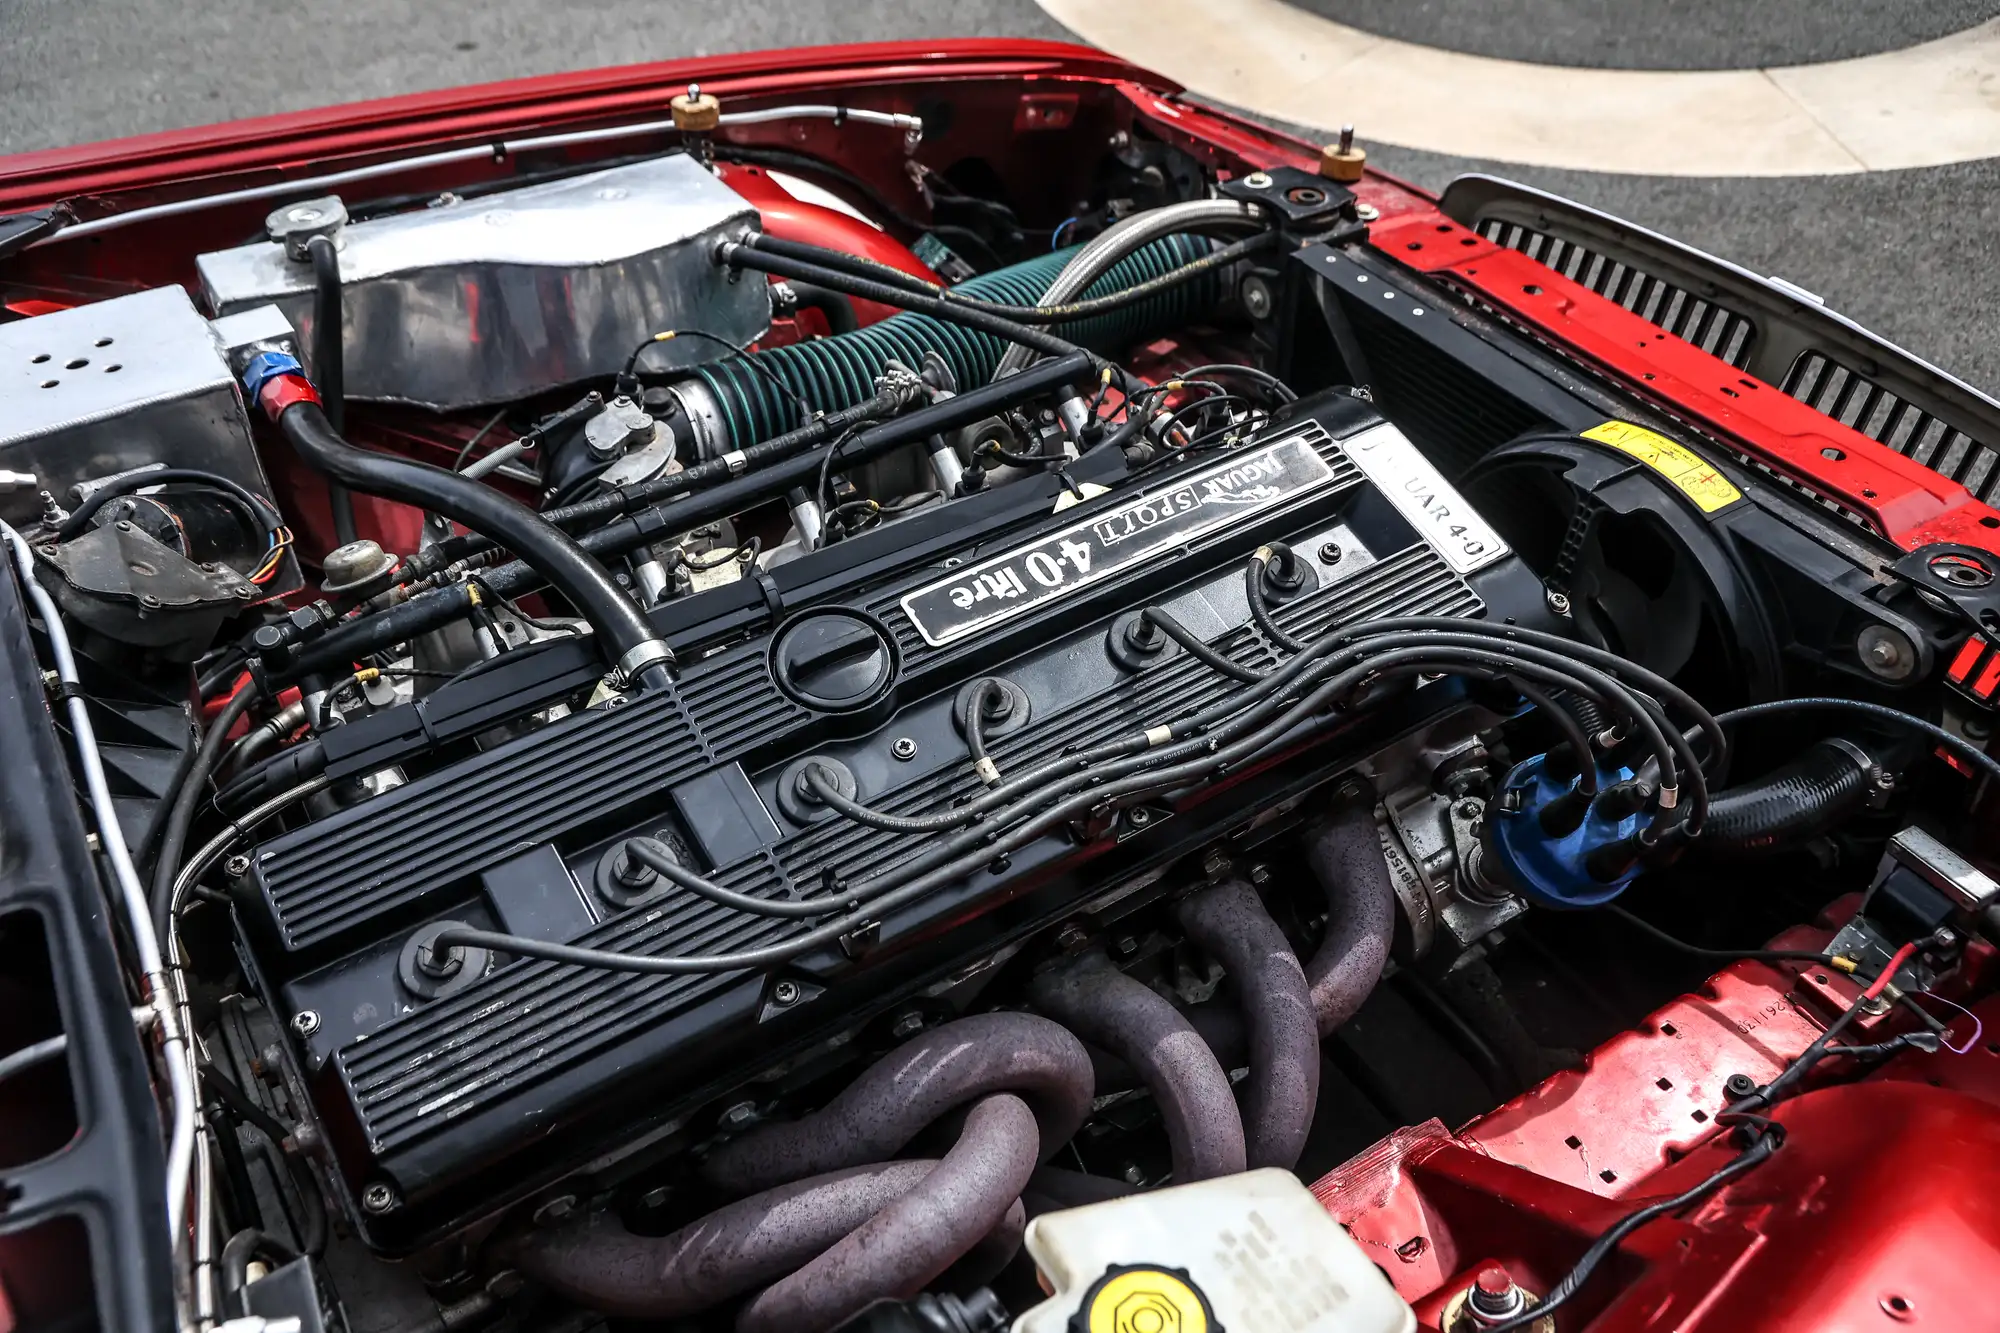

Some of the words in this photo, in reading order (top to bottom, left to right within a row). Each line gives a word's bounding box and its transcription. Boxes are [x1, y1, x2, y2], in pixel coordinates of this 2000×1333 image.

[1201, 452, 1286, 494] JAGUAR
[1361, 441, 1450, 523] JUAR
[948, 564, 1028, 609] litre
